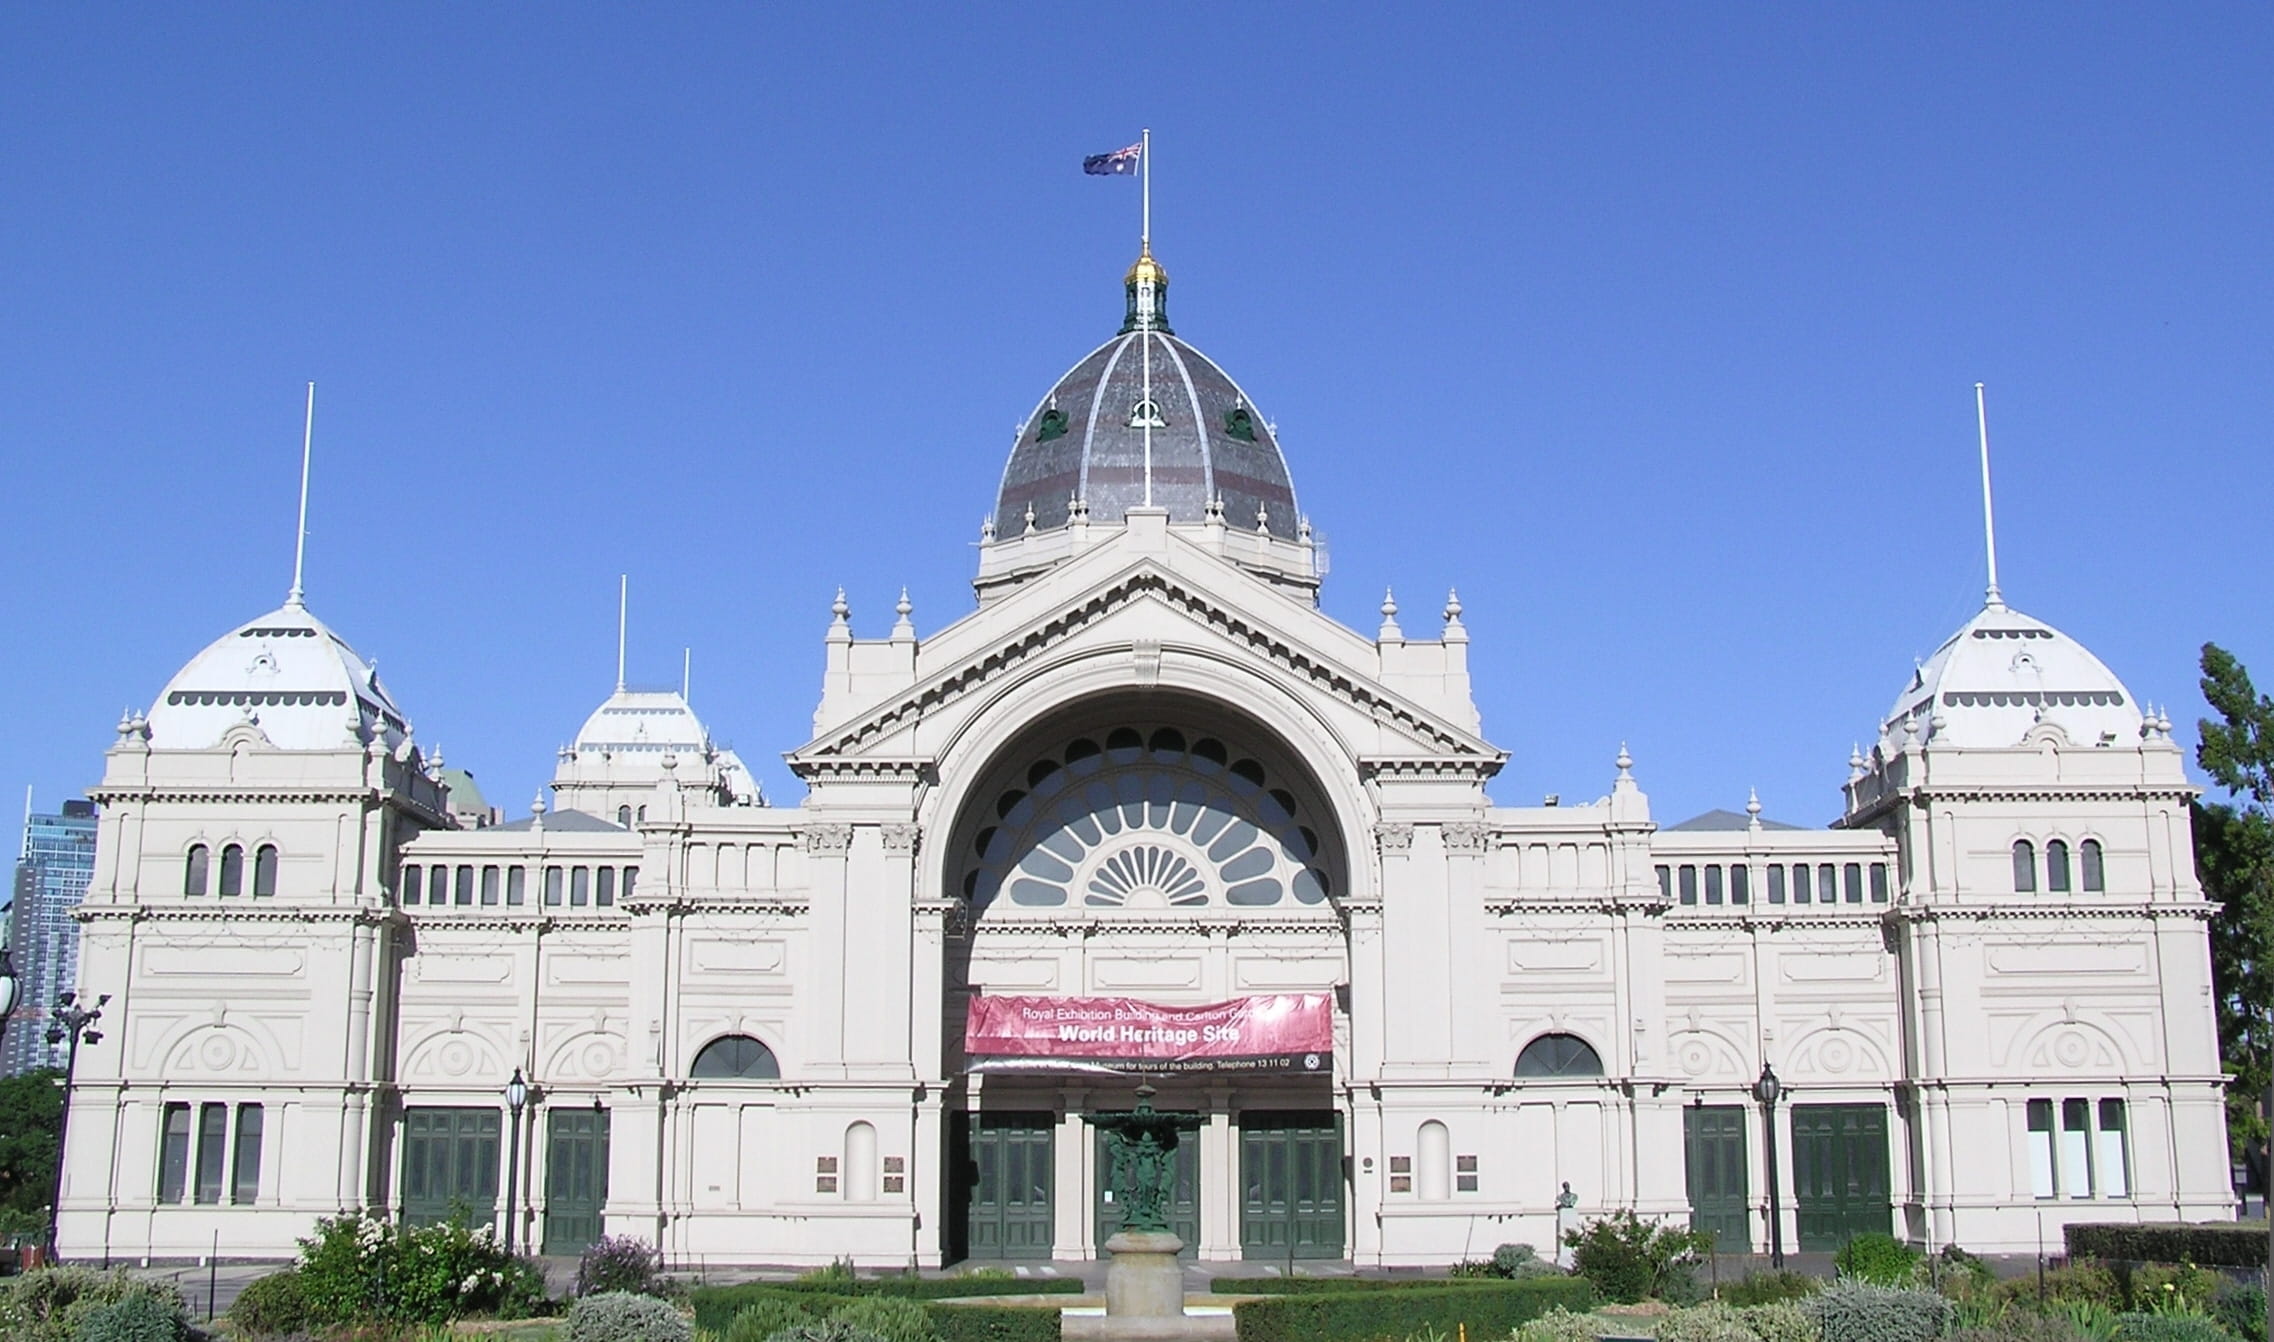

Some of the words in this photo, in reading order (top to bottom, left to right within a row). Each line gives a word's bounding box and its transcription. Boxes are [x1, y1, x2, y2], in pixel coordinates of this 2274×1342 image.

[1022, 1007, 1053, 1021] Royal
[1057, 1008, 1111, 1020] Exhibition
[1060, 1025, 1117, 1041] World
[1120, 1025, 1198, 1046] Heritage
[1203, 1024, 1240, 1041] Site
[1126, 1061, 1137, 1070] for
[1160, 1062, 1167, 1070] of
[1169, 1061, 1182, 1070] the
[1217, 1061, 1256, 1070] Telephone
[1258, 1059, 1267, 1068] 13
[1269, 1059, 1278, 1067] 11
[1280, 1059, 1290, 1067] 02
